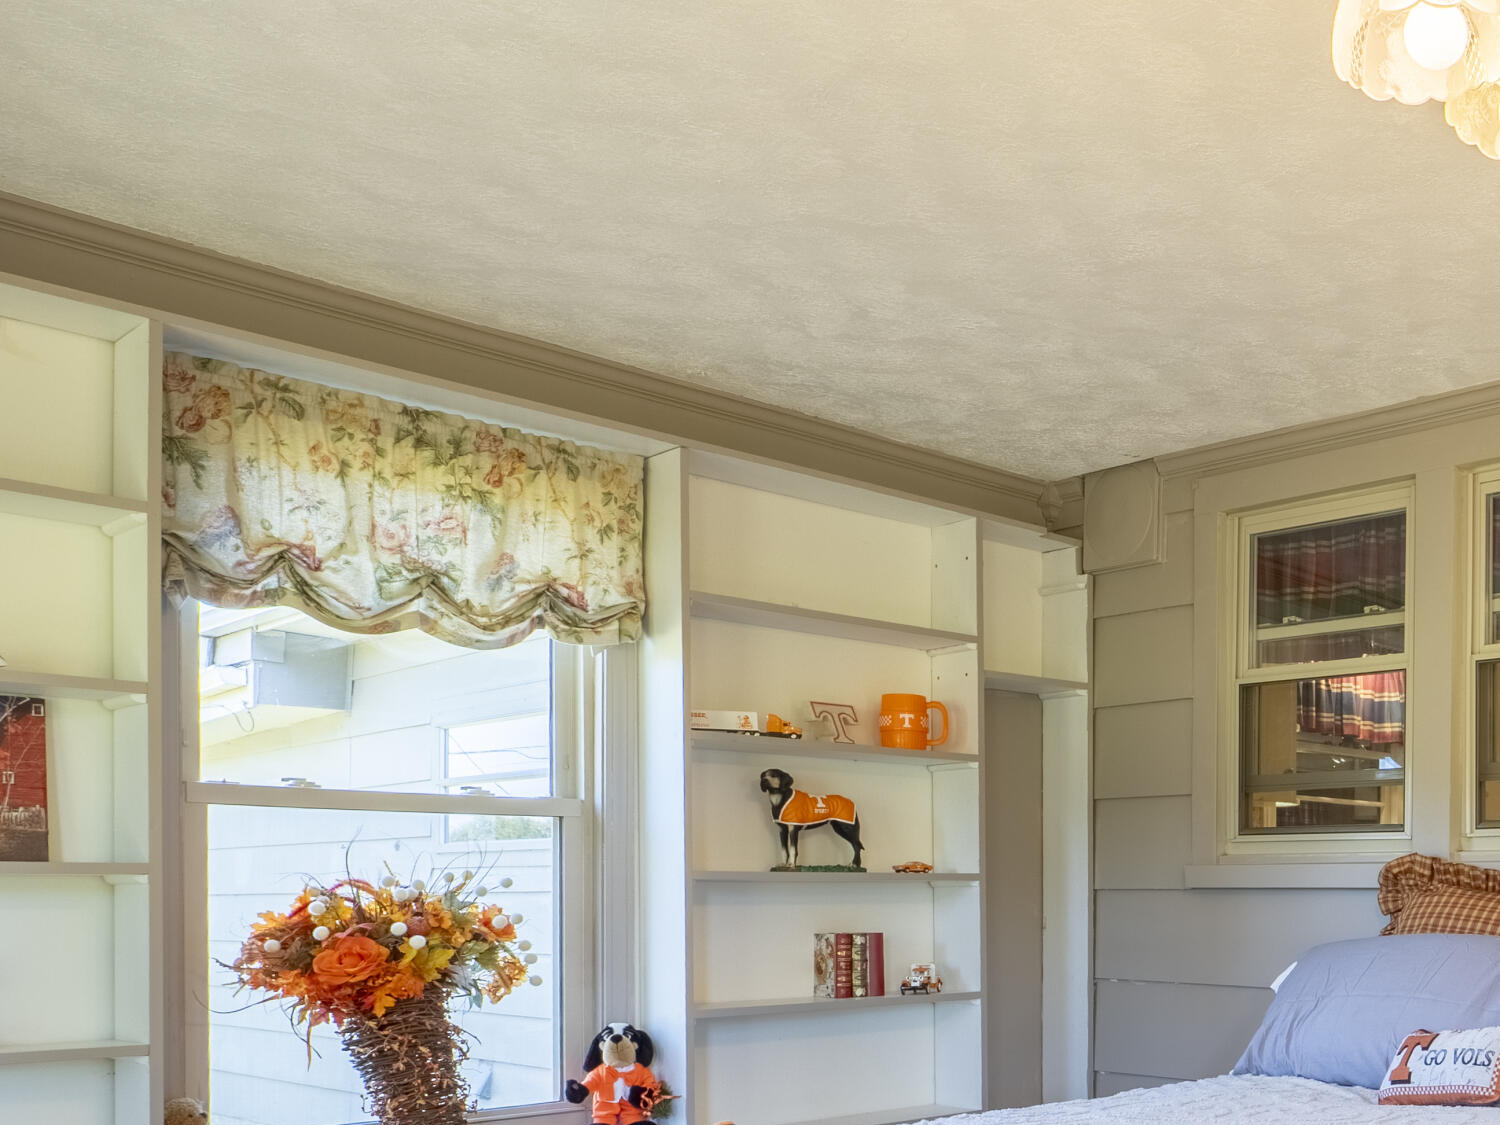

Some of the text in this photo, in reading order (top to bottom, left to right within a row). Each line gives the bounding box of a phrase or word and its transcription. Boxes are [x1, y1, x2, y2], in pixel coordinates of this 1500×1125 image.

[810, 701, 858, 744] T
[900, 714, 914, 728] T
[1424, 1047, 1495, 1067] GO VOLS
